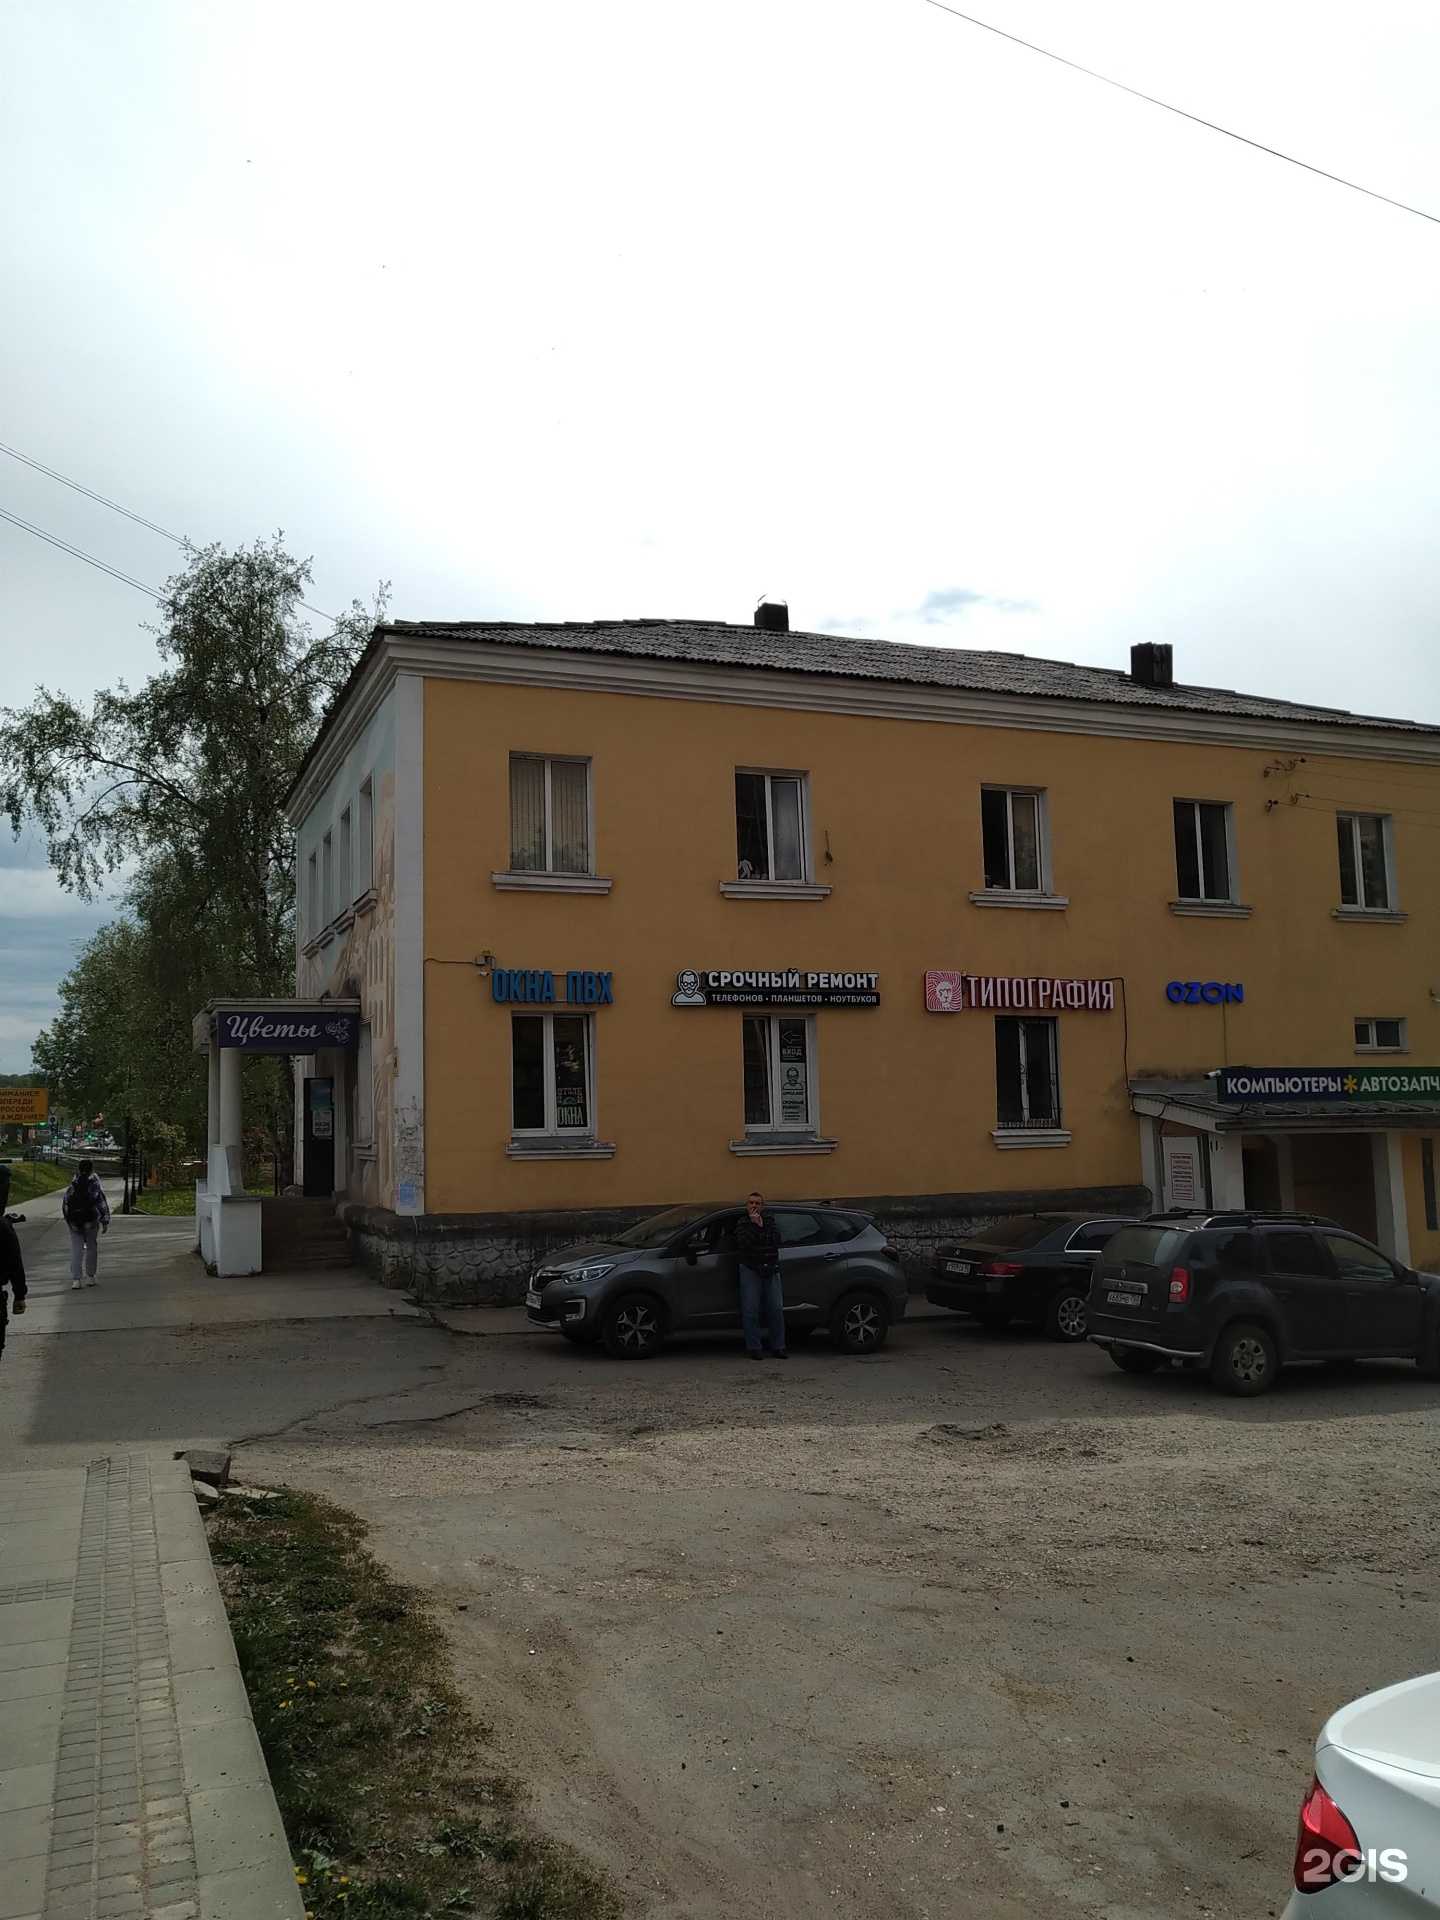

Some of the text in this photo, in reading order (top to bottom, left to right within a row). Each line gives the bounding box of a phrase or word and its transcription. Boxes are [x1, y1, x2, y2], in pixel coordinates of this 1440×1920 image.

[492, 968, 613, 1004] ОКНА ПВХ
[708, 968, 879, 989] СРОЧНЫЙ РЕМОНТ
[711, 994, 877, 1004] ТЕЛЕФОНОВ ПЛАНШЕТОВ НОУТБУКОВ
[965, 976, 1114, 1009] ТИПОГРАФИЯ
[1166, 981, 1244, 1005] OZON
[226, 1015, 322, 1046] Цветы
[1226, 1074, 1440, 1094] КОМПЬЮТЕРЫ АВТОЗАПЧ
[557, 1105, 584, 1125] ОКНА
